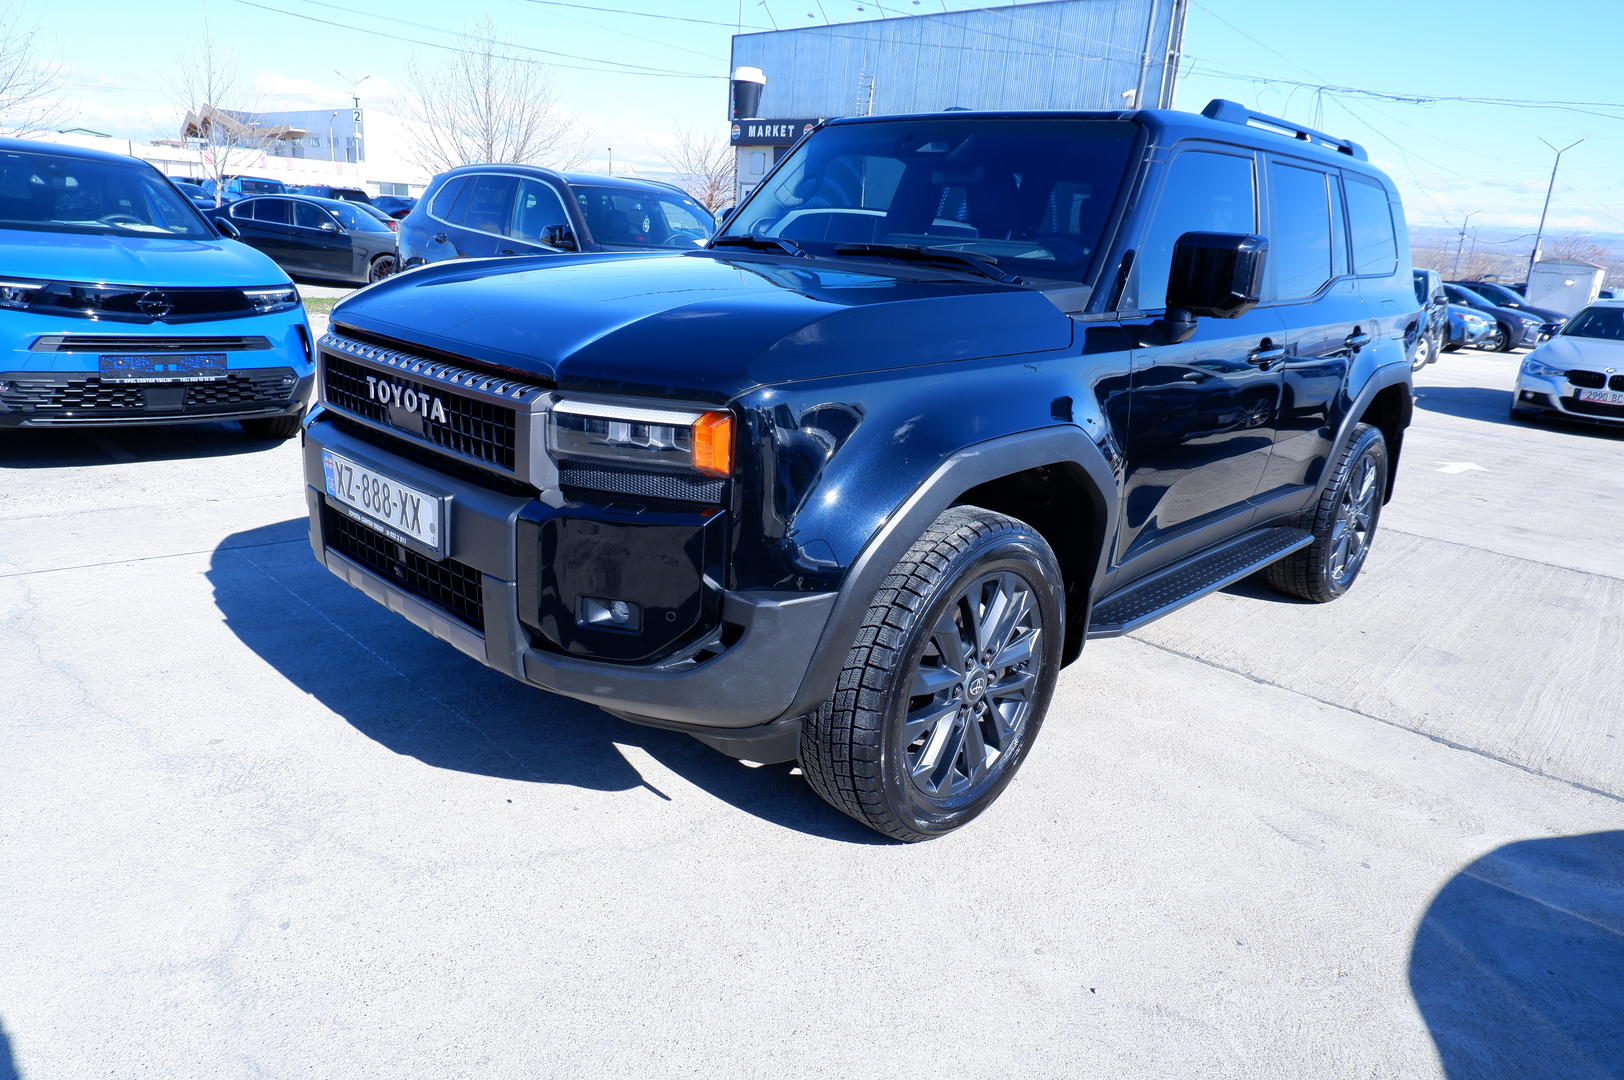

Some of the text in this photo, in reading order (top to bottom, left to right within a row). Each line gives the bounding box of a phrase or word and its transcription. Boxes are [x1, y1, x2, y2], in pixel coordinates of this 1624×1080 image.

[354, 111, 361, 122] 2
[748, 125, 795, 138] MARKET
[366, 375, 447, 424] TOYOTA
[335, 460, 422, 535] XZ-888-XX
